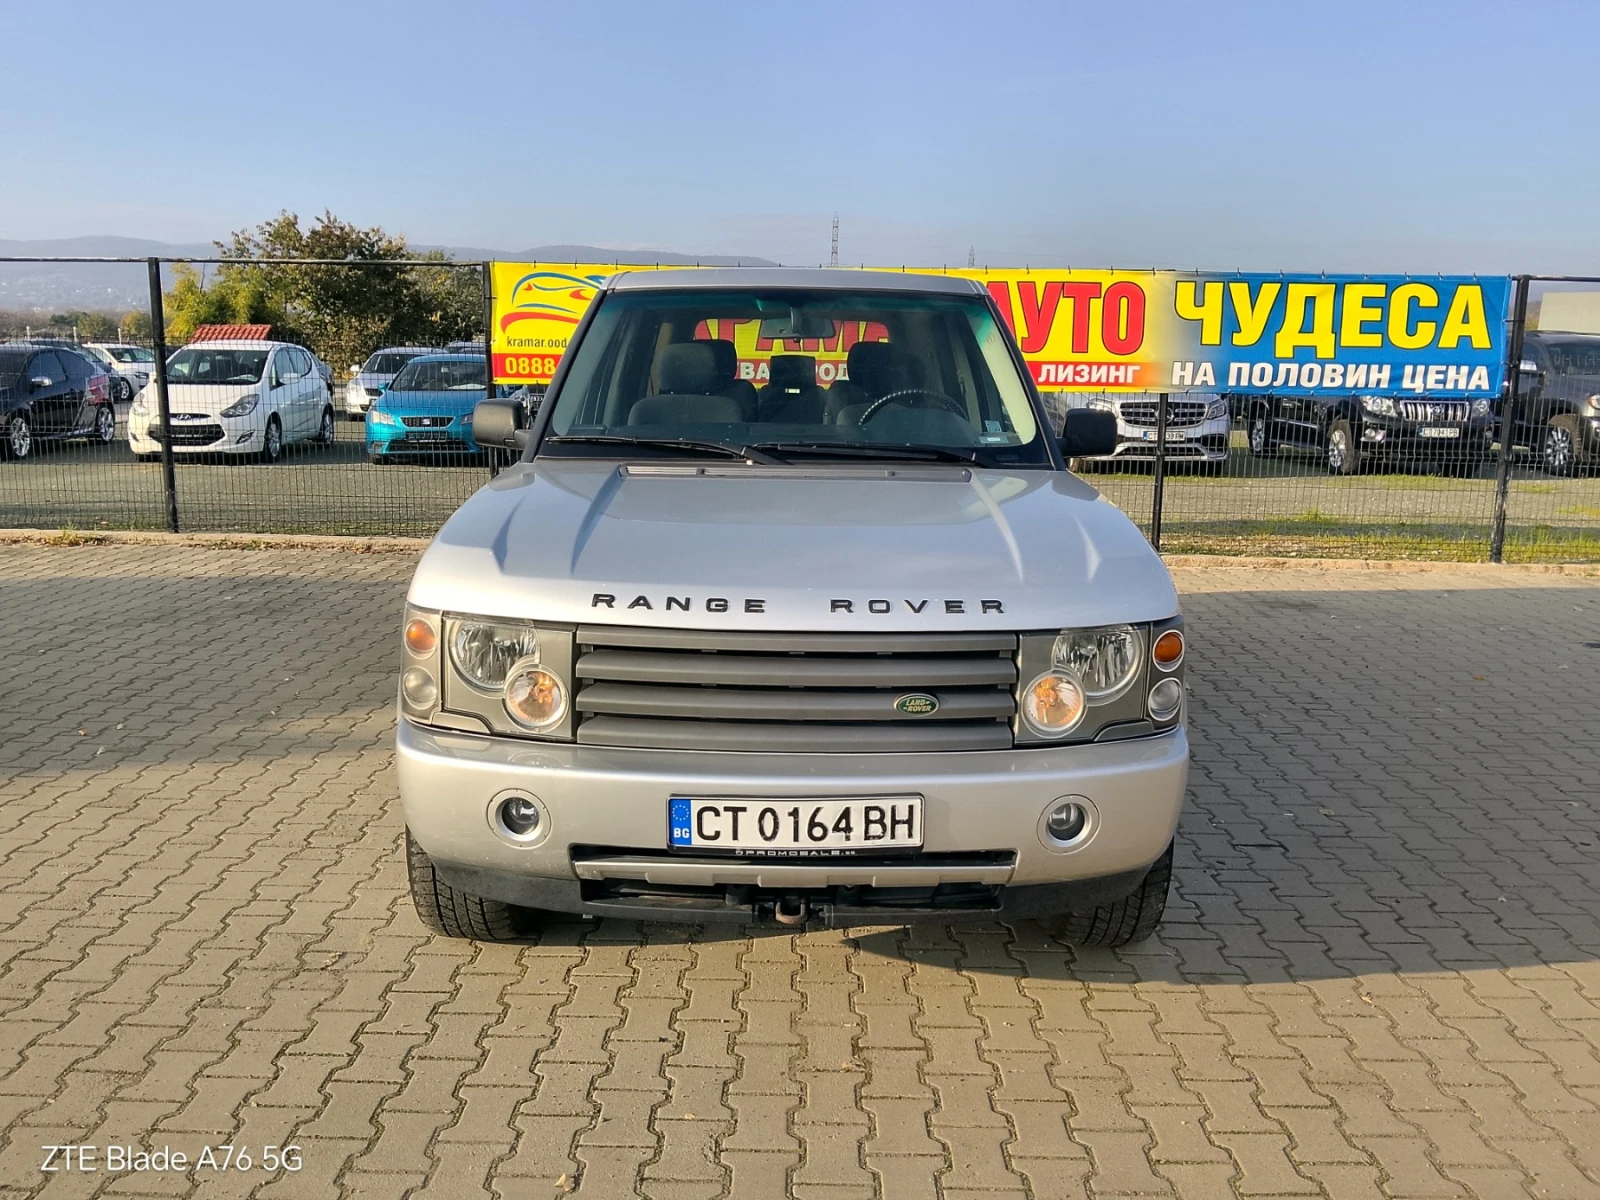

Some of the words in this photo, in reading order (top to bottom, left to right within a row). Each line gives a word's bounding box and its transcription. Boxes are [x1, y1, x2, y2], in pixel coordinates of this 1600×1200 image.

[1174, 281, 1493, 359] ЧУДЕСА
[507, 336, 567, 348] kramar.ood
[505, 356, 556, 375] 0888
[1038, 364, 1140, 383] ЛИЗИНГ
[1171, 361, 1216, 387] НА
[1228, 362, 1391, 388] ПОЛОВИН
[1402, 365, 1489, 393] ЦЕНА
[591, 593, 767, 614] RANGE
[830, 598, 1005, 614] ROVER
[673, 827, 690, 839] BG
[696, 806, 747, 841] CT
[758, 806, 853, 842] 0164
[864, 804, 914, 841] BH
